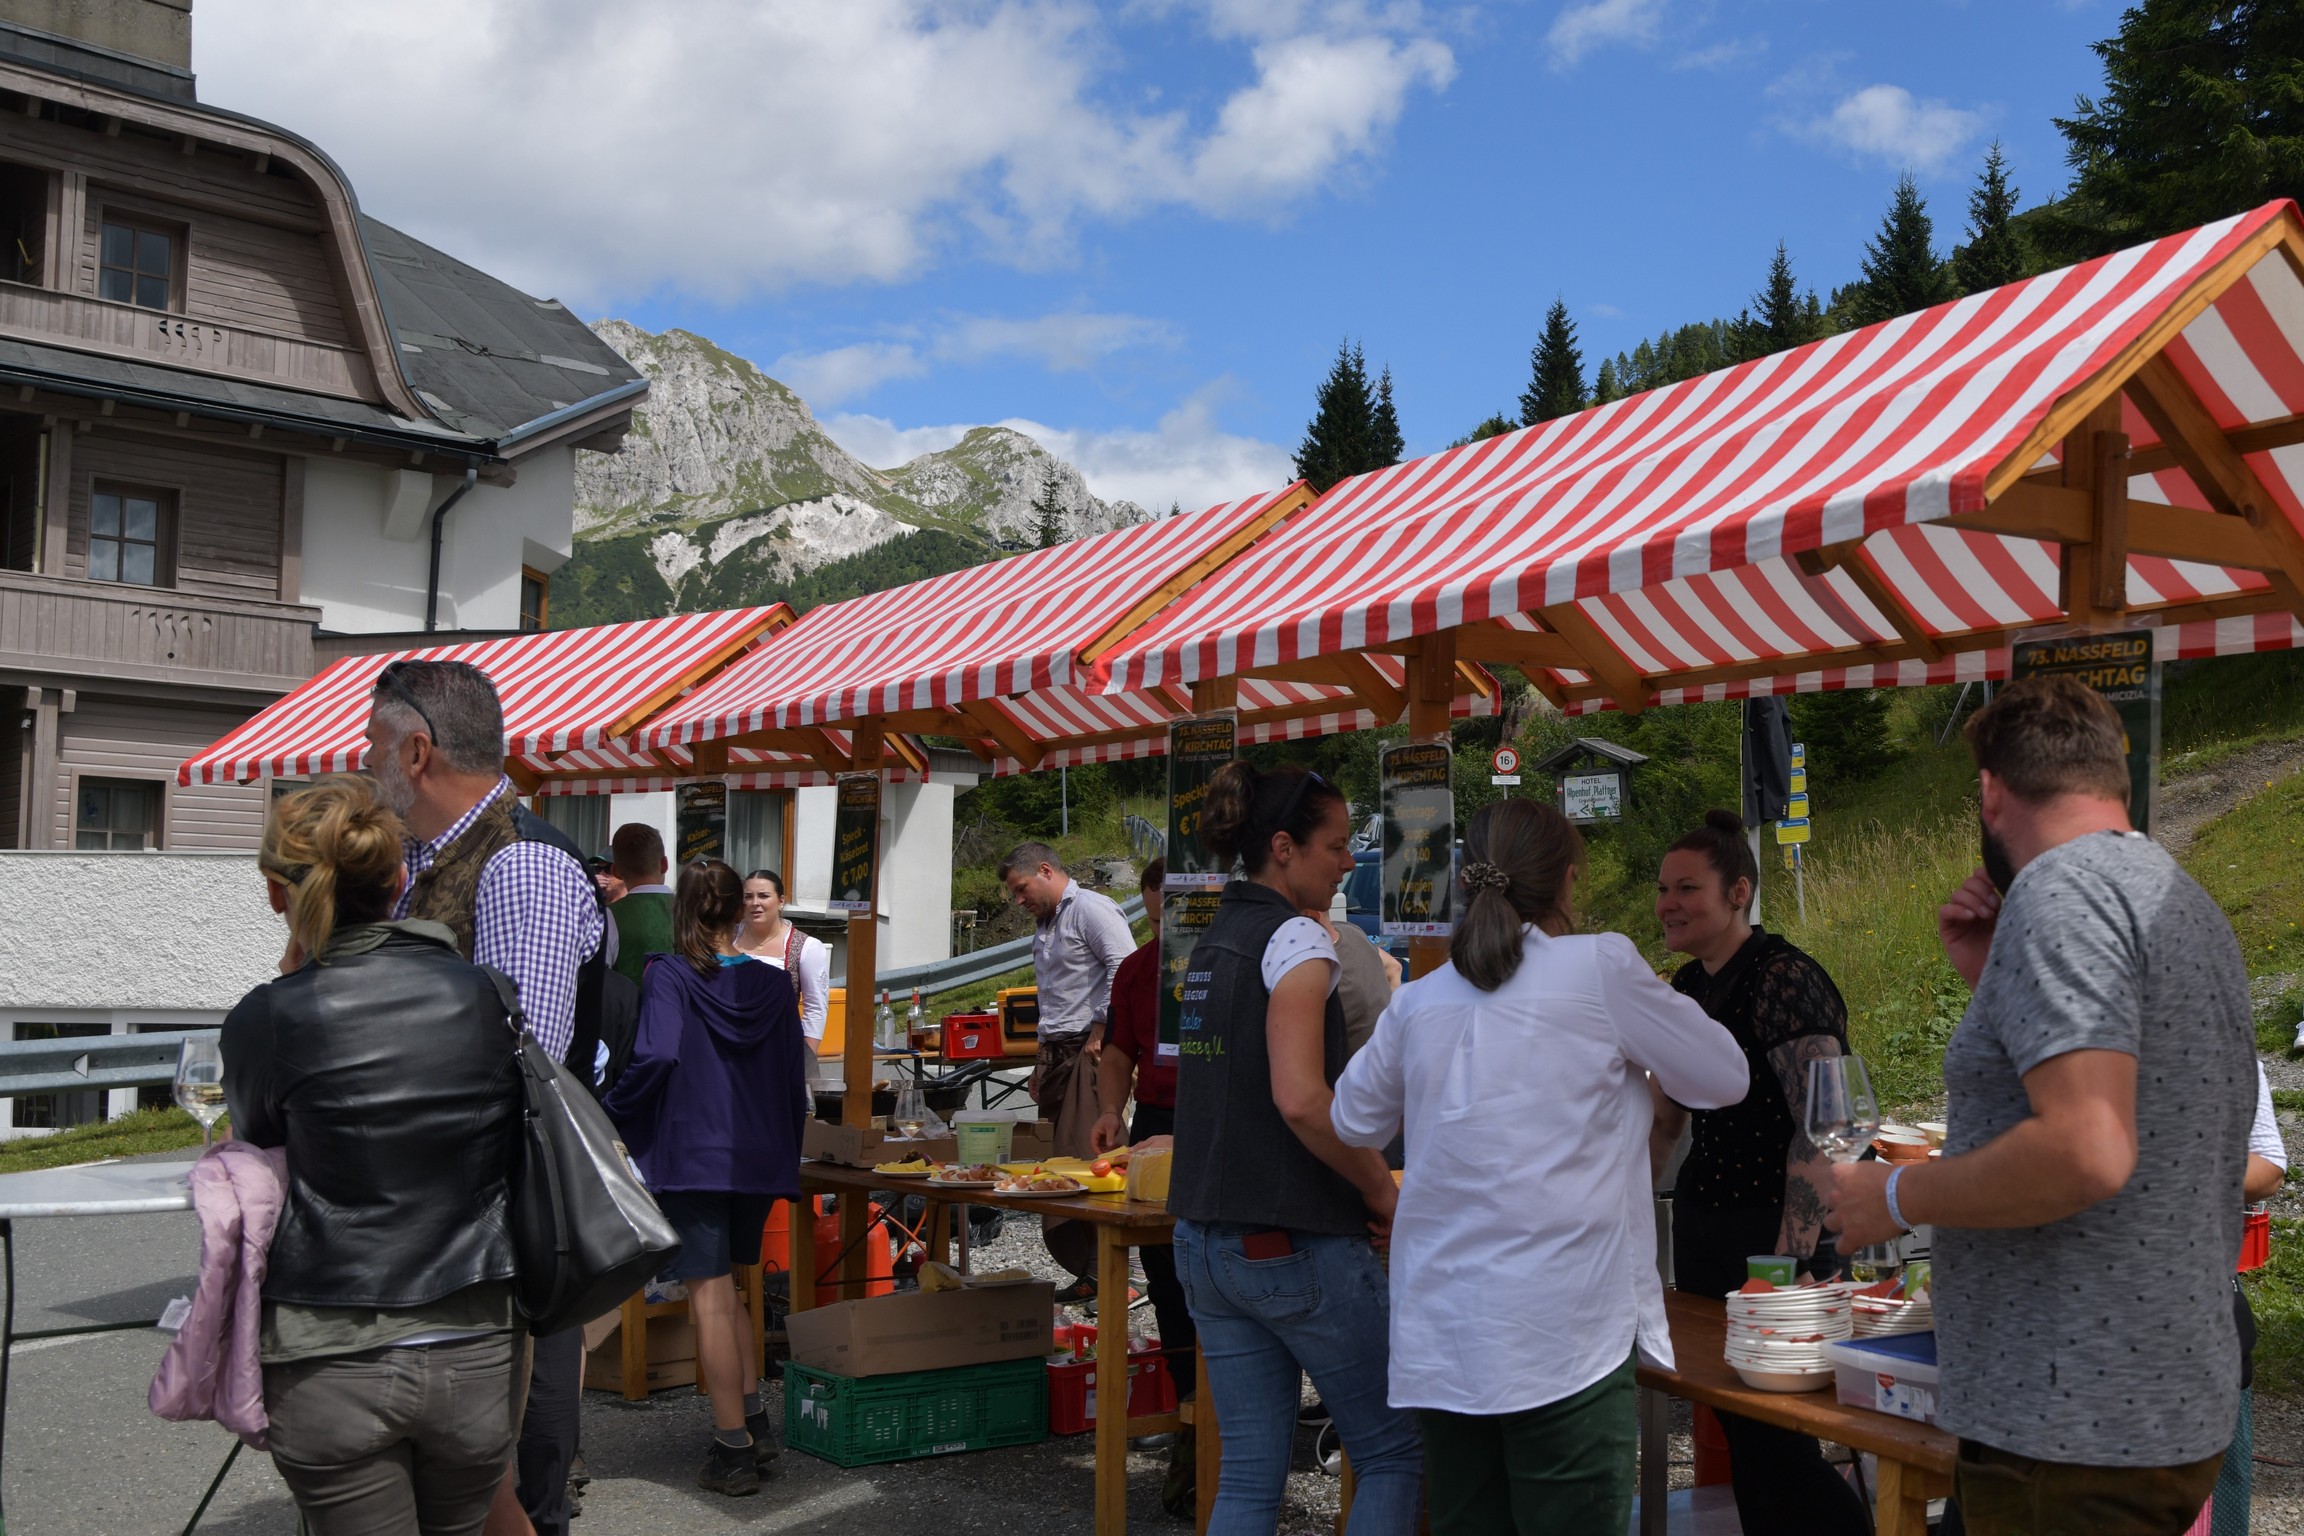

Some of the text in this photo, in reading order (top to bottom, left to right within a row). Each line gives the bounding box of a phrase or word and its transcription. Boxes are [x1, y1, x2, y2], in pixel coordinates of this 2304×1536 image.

[2027, 639, 2148, 666] 73. NASSFELD
[1184, 738, 1232, 753] KIRCHTAG
[1581, 777, 1602, 785] HOTEL
[1187, 971, 1212, 982] GENUSS
